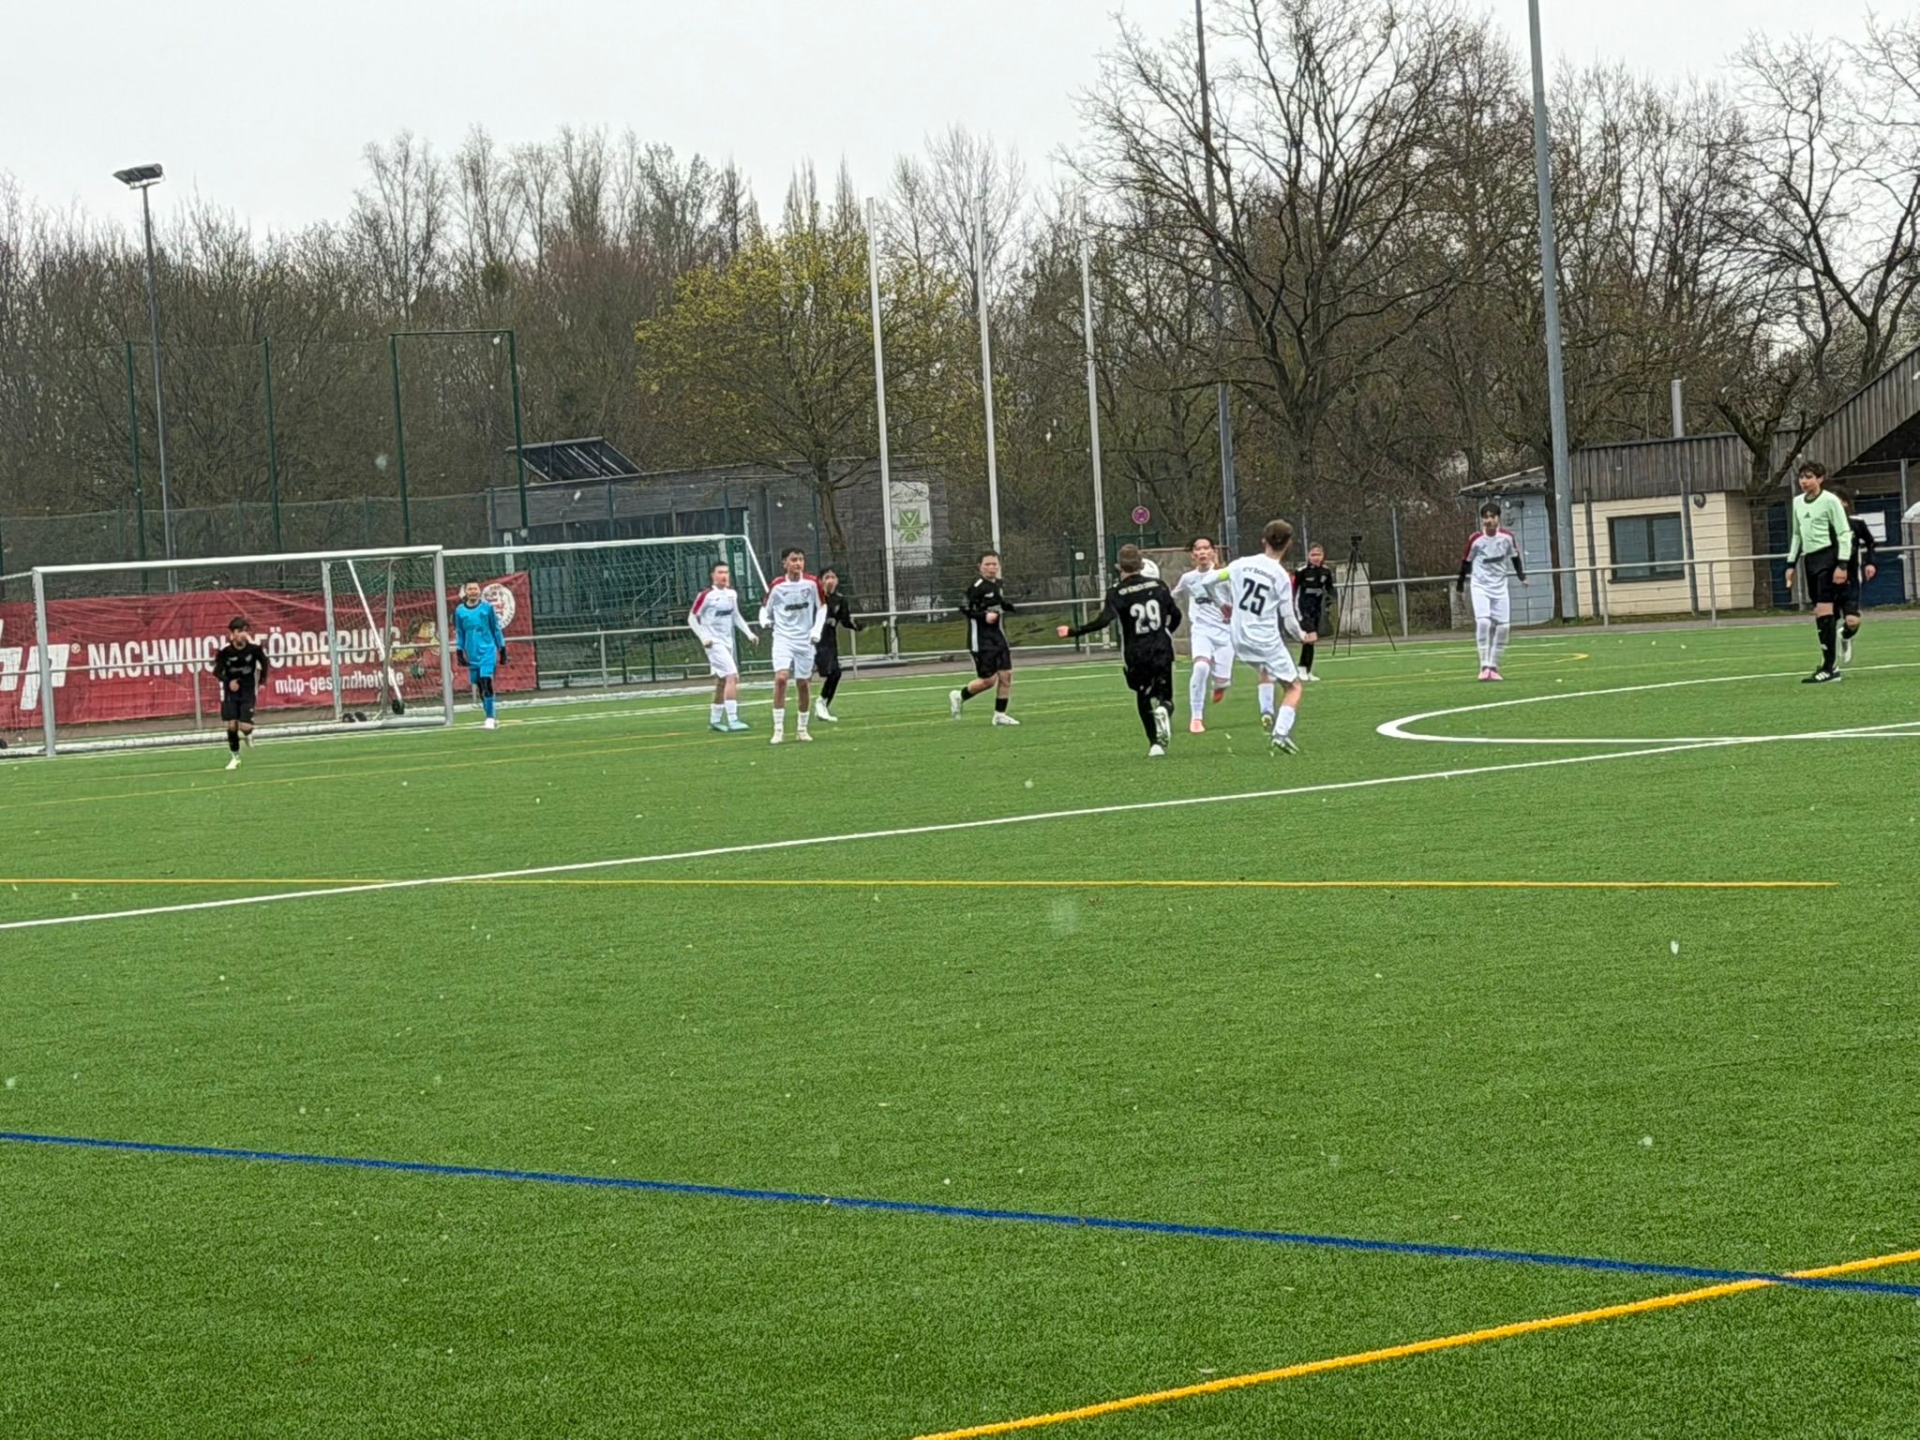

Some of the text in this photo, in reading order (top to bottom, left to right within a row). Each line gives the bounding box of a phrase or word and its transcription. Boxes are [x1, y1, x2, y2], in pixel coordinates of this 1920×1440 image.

[1238, 577, 1270, 616] 25
[1129, 599, 1161, 634] 29
[275, 668, 405, 697] mhp-gesndheitde
